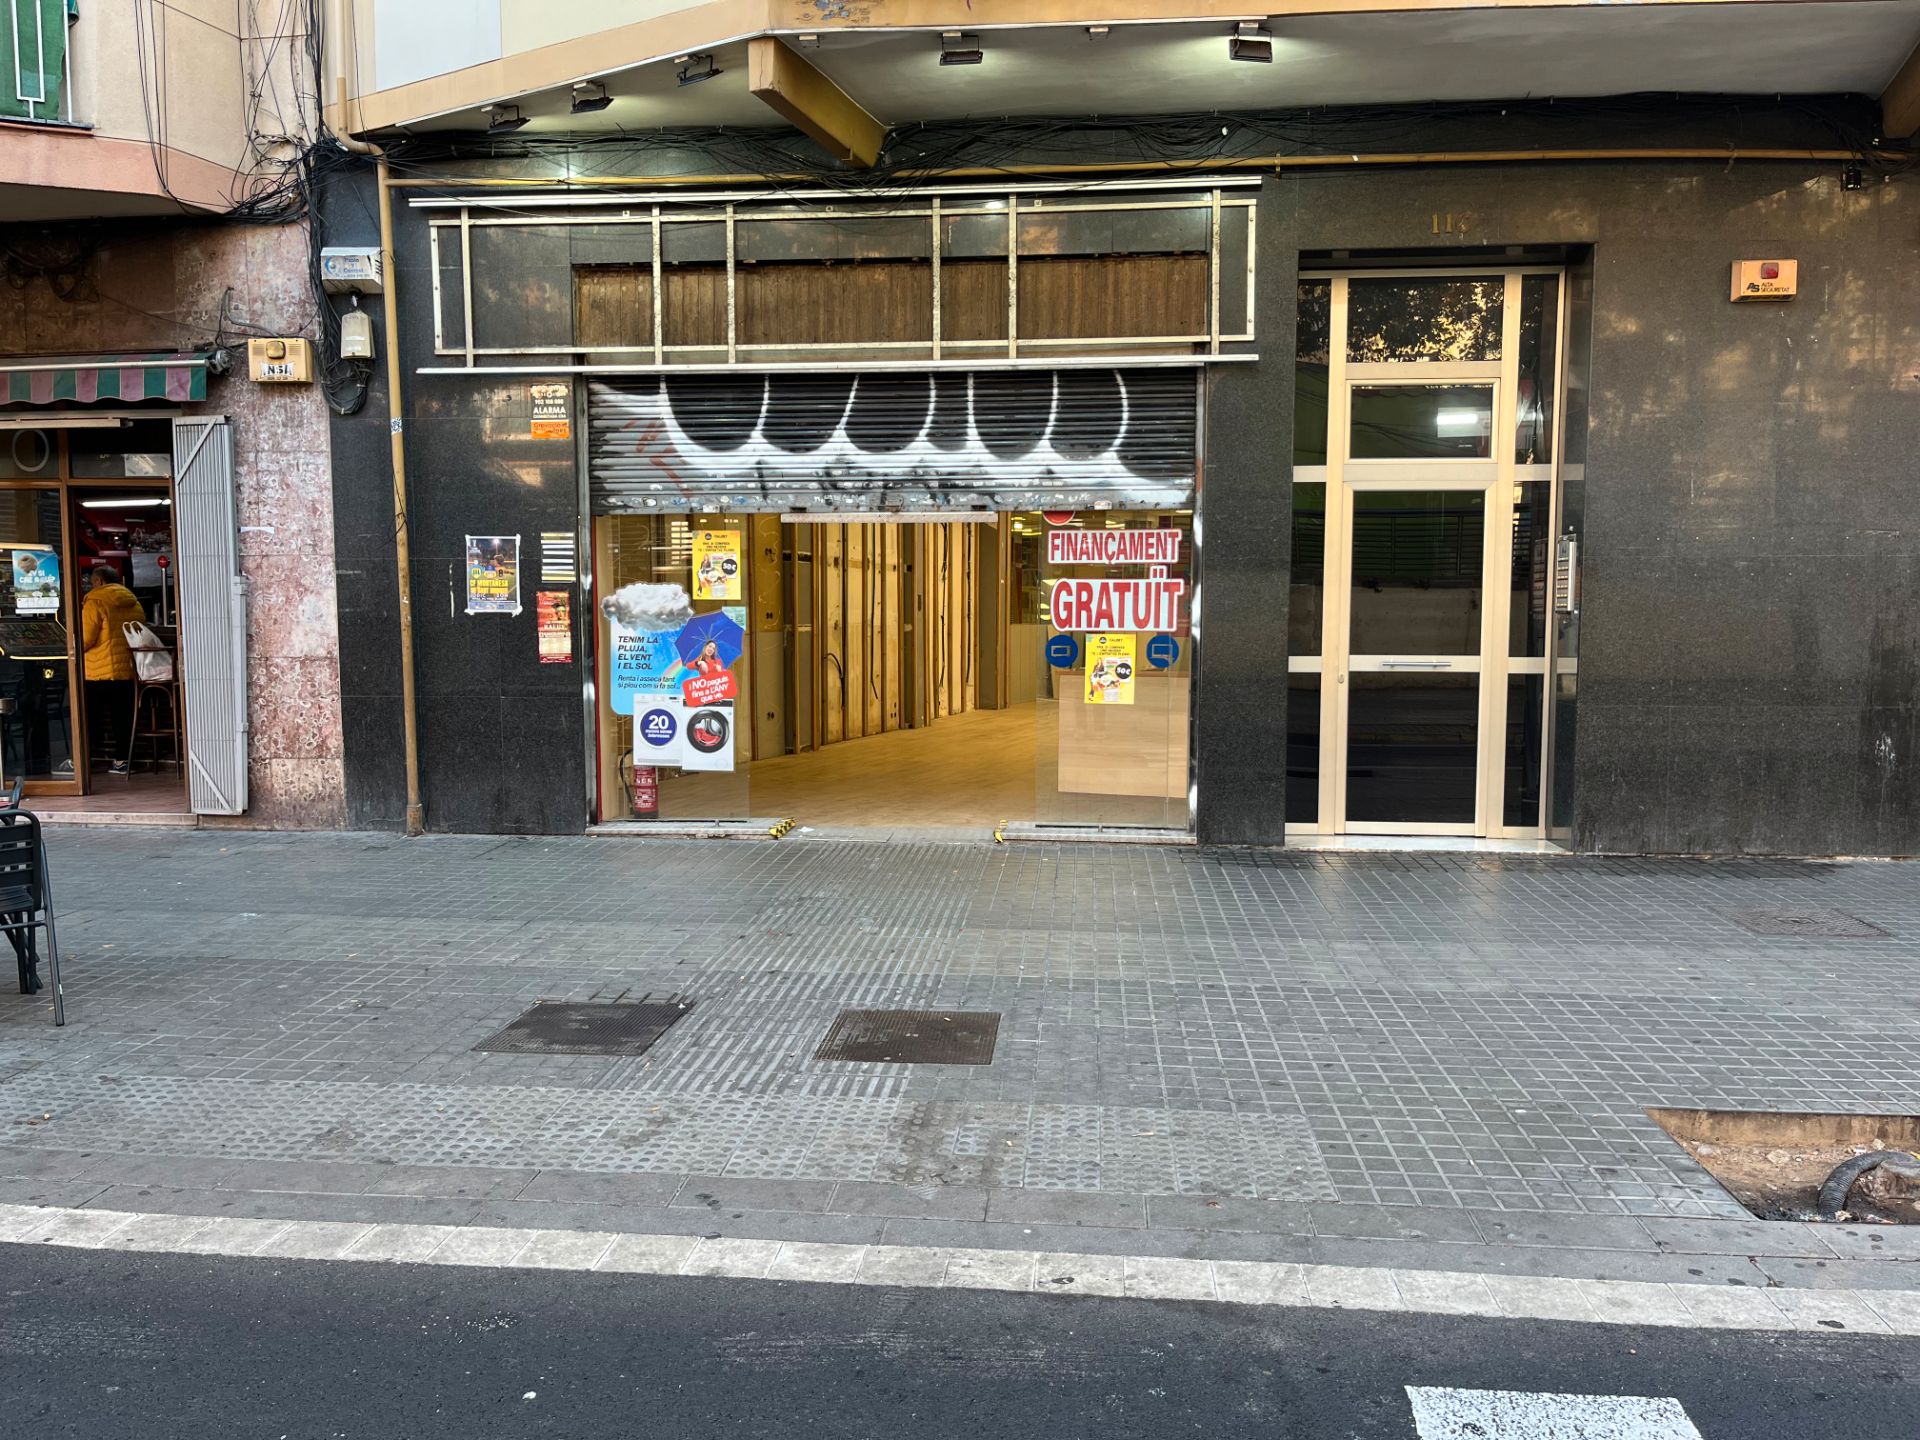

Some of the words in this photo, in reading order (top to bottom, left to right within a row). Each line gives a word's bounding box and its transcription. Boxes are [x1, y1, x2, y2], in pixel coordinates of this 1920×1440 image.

[533, 406, 567, 414] ALARMA
[1050, 531, 1179, 563] FINANÇAMENT
[1053, 568, 1181, 630] GRATUÏT
[618, 636, 645, 644] TENIM
[647, 636, 659, 644] LA
[618, 645, 648, 653] PLUJA,
[707, 675, 729, 688] paguis
[691, 690, 704, 698] fins
[710, 683, 729, 694] L'ANY
[701, 695, 714, 704] que
[648, 714, 669, 730] 20
